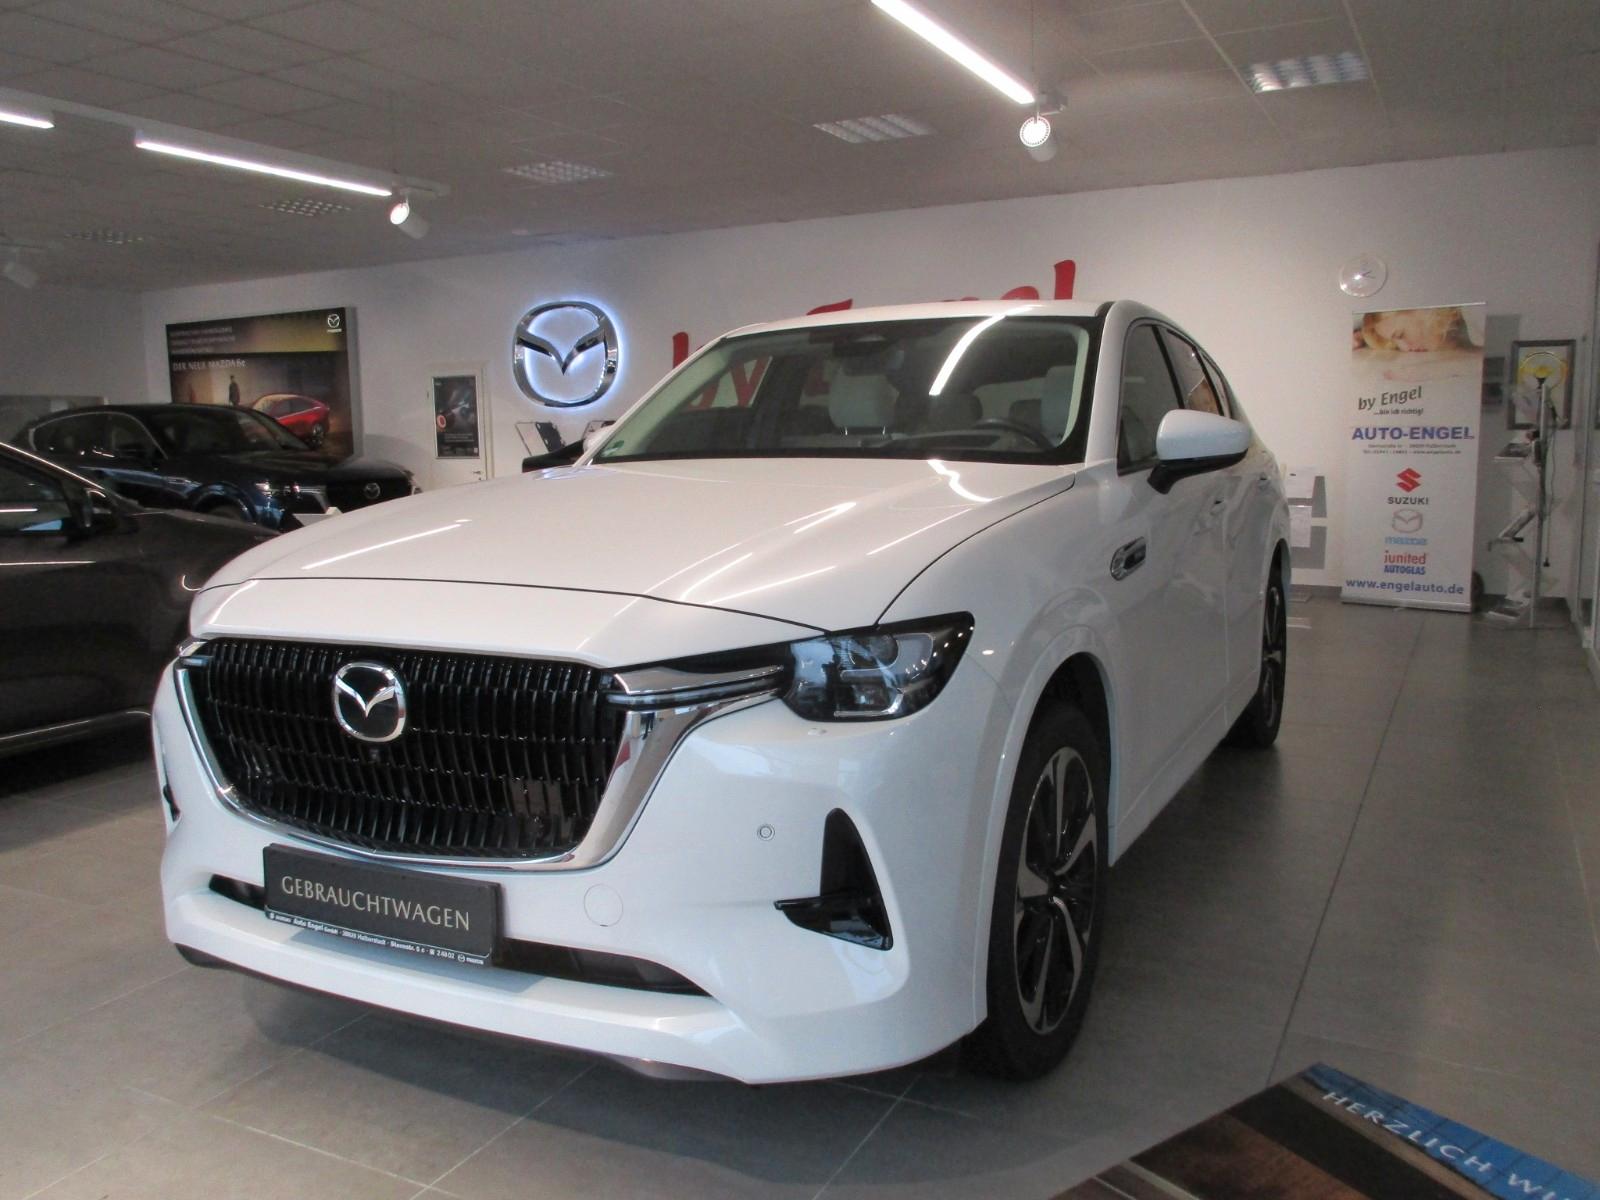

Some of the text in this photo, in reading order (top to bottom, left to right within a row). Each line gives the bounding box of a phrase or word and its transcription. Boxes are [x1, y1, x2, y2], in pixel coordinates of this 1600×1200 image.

[1357, 385, 1423, 411] by Engel
[1351, 426, 1475, 441] AUTO-ENGEL
[1387, 496, 1429, 505] SUZUKI
[1383, 550, 1427, 565] junited
[1383, 564, 1426, 575] AUTOGLAS
[1345, 578, 1465, 595] www.engelauto.de
[280, 875, 471, 931] GEBRAUCHTWAGEN
[1322, 1091, 1493, 1173] HERZLICH
